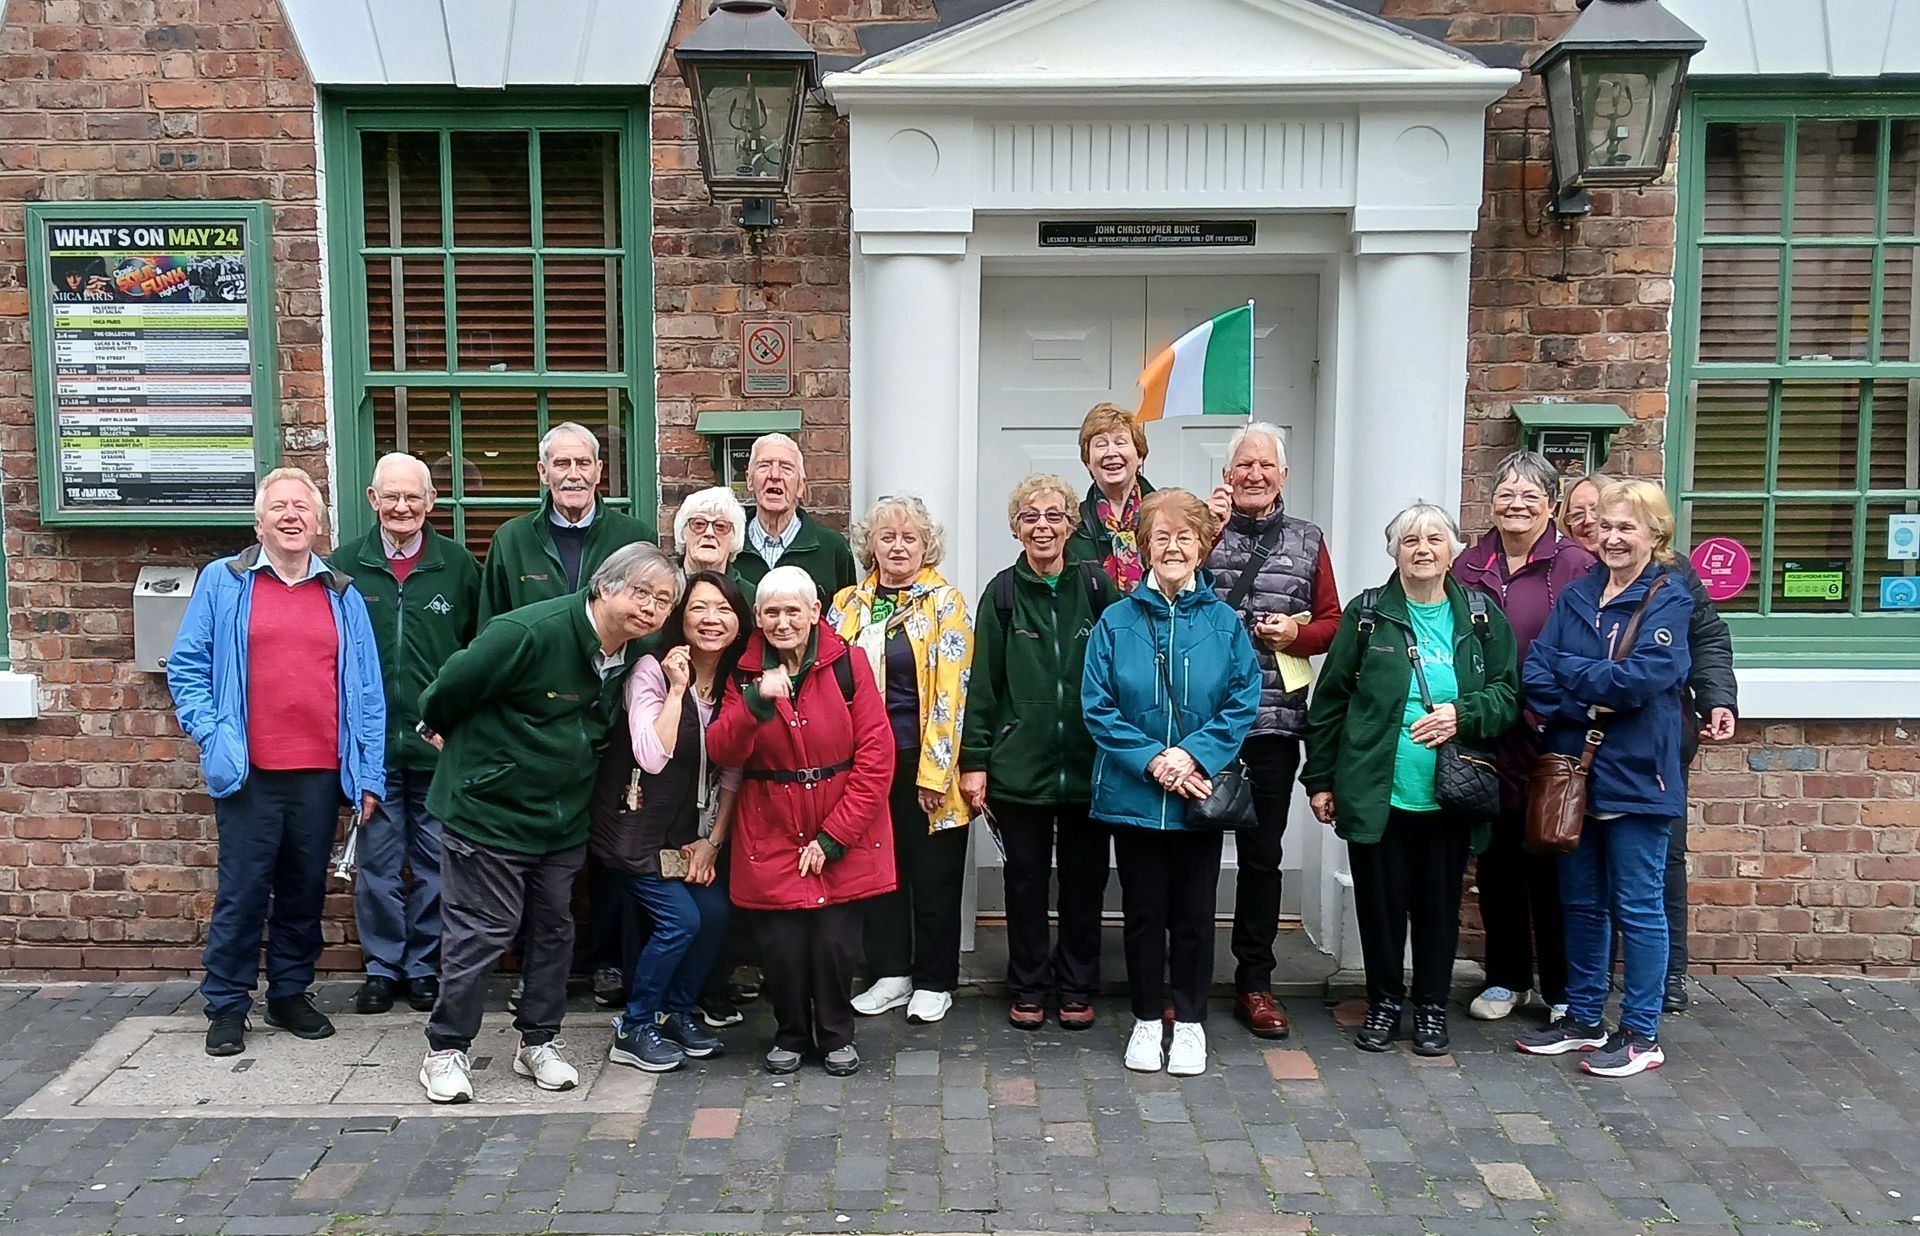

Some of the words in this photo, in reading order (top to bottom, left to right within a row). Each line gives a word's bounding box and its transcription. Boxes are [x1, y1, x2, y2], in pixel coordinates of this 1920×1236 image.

[1095, 225, 1115, 234] JOHN
[1117, 225, 1171, 234] CHRISTOPHER
[1174, 225, 1200, 234] BUNCE
[54, 228, 131, 247] WHAT'S
[134, 228, 164, 247] ON
[168, 228, 239, 246] MAY'24
[1205, 234, 1214, 242] ON
[116, 264, 155, 292] SOUL
[141, 266, 187, 297] FUNK
[53, 291, 83, 301] MICA
[81, 488, 96, 497] JAM
[1831, 585, 1837, 593] 5
